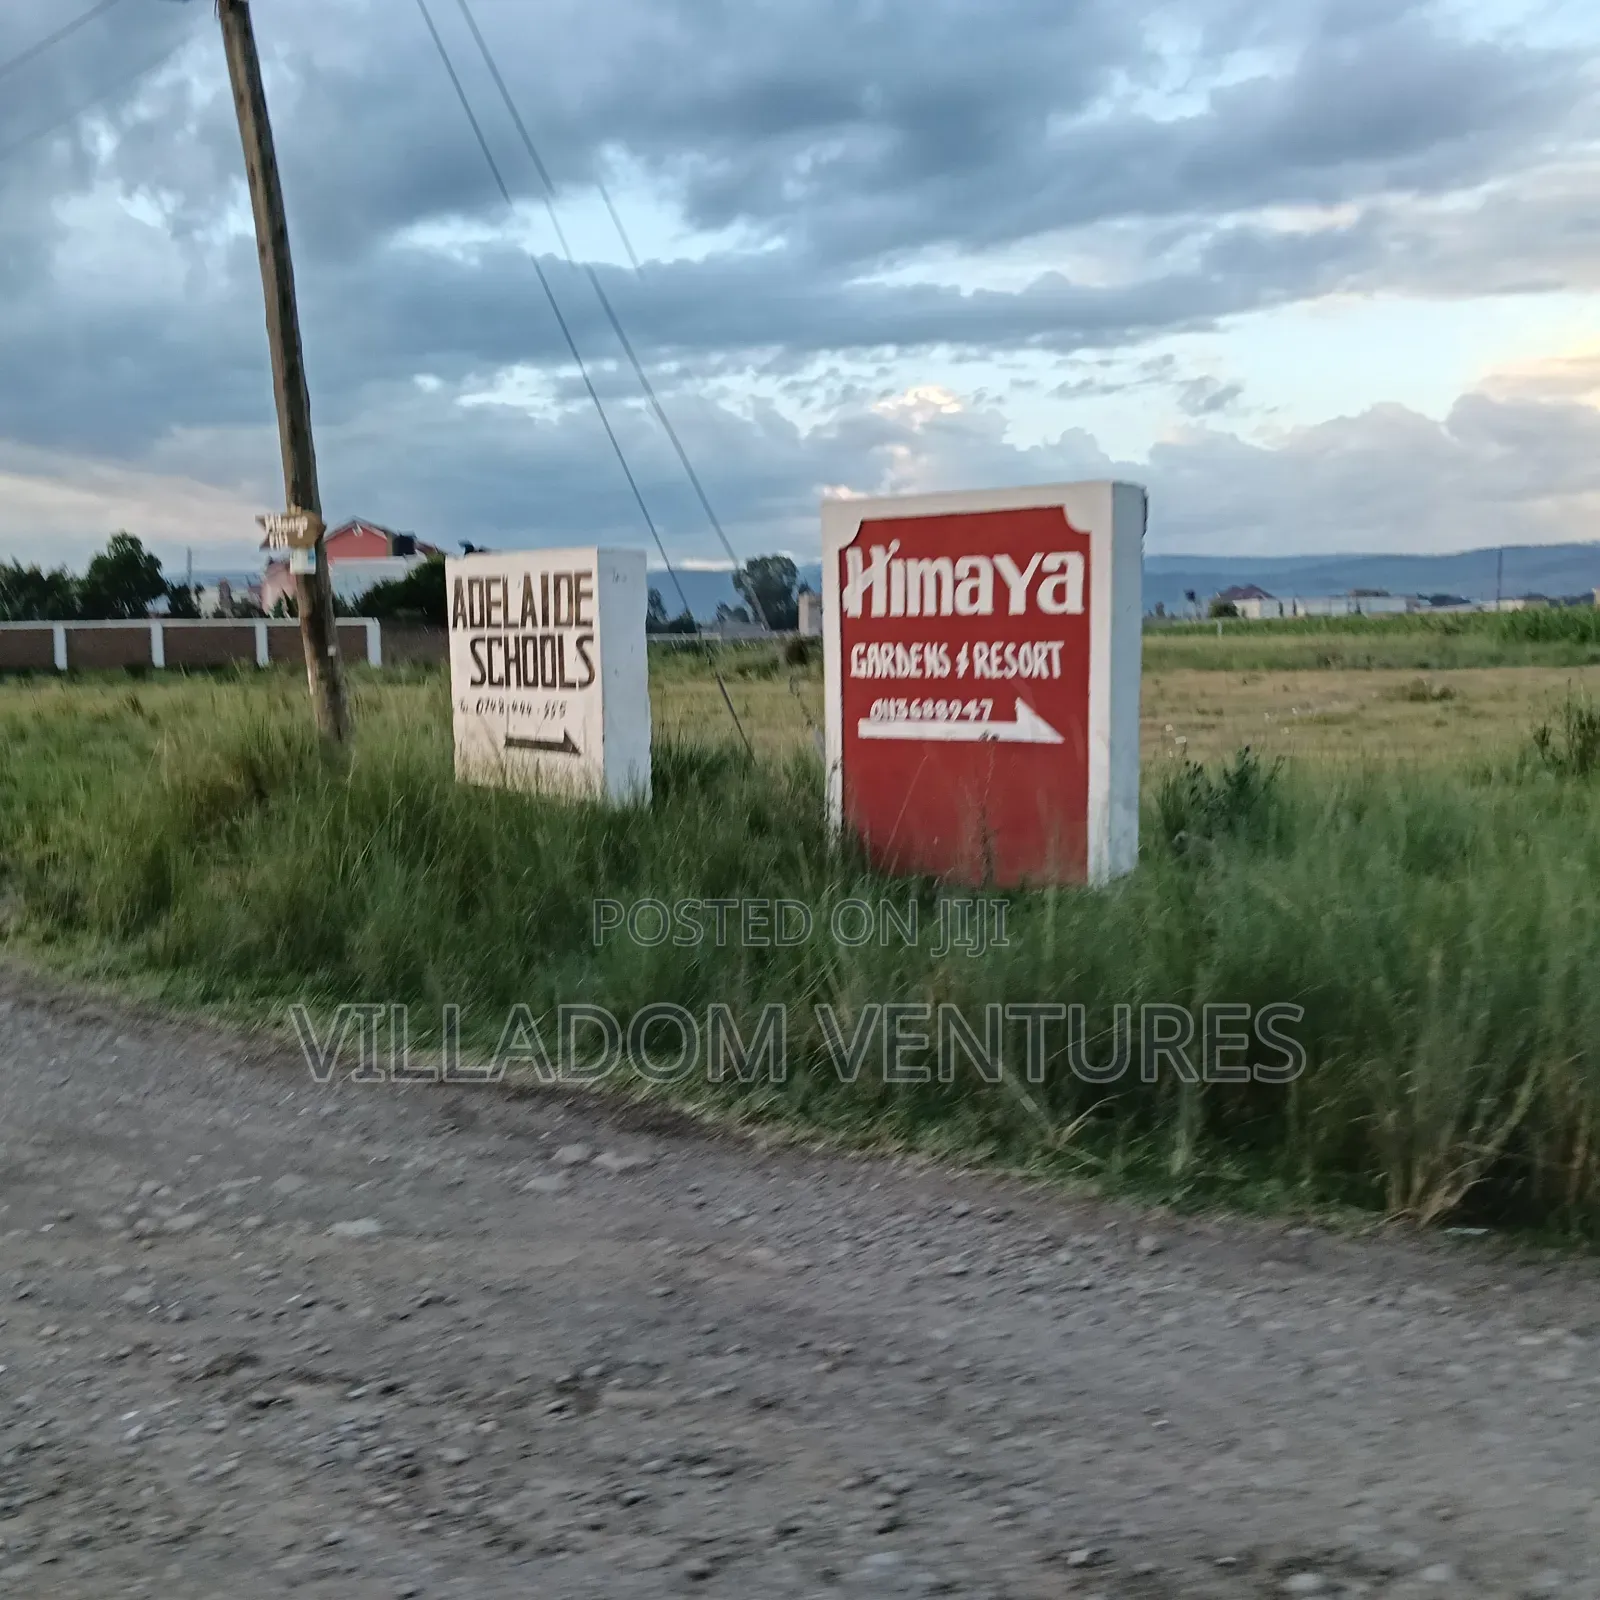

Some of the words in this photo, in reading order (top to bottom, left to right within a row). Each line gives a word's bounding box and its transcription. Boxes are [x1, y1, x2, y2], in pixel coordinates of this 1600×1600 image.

[452, 571, 593, 628] ADELAIDE
[470, 634, 596, 689] SCHOOLS
[850, 641, 951, 679] GARDENS
[973, 640, 1064, 679] RESORT
